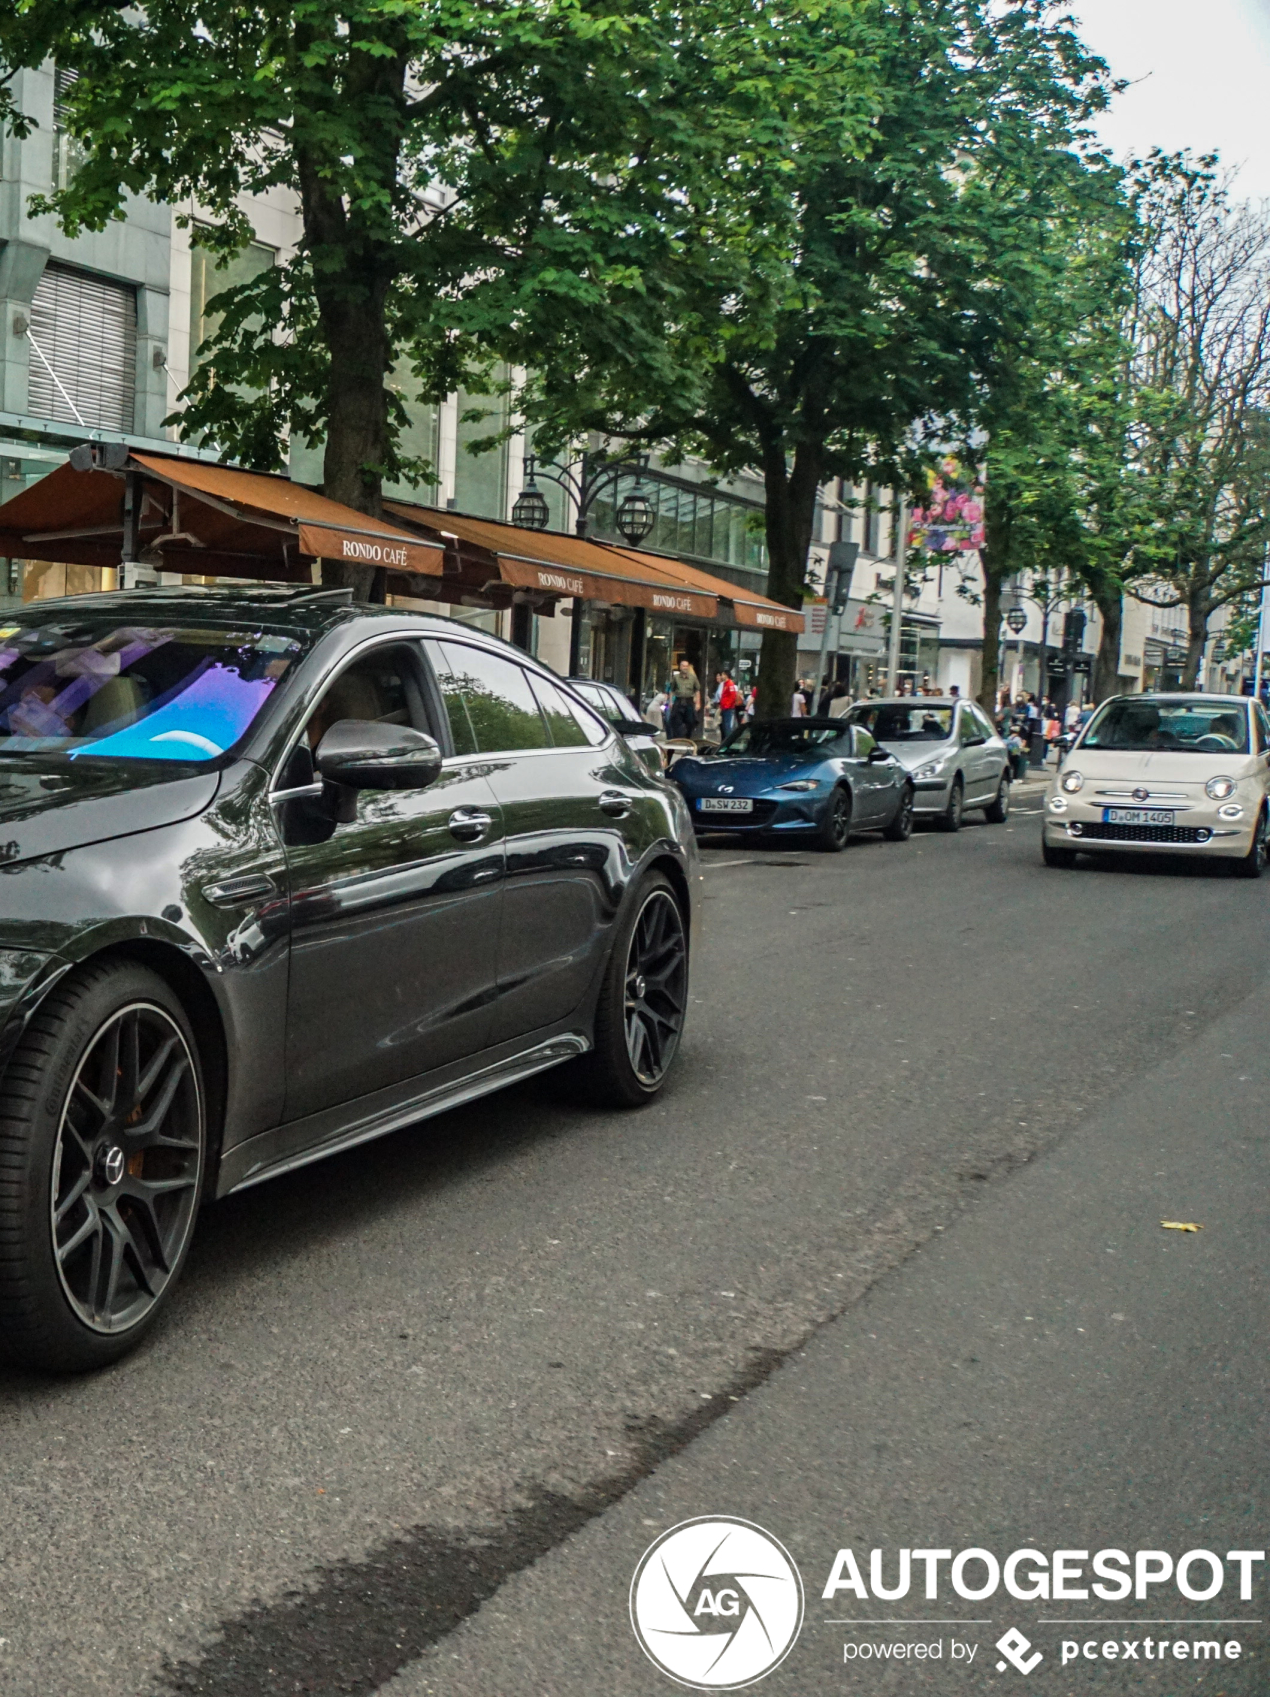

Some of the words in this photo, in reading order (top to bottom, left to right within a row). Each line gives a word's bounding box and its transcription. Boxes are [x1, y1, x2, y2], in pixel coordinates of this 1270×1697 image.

[342, 539, 382, 561] RONDO
[383, 546, 408, 566] CAFÉ
[537, 571, 567, 590] RONDO
[566, 577, 584, 595] CAFÉ
[652, 594, 676, 609] RONDO
[675, 596, 693, 612] CAFÉ
[705, 800, 711, 809] D
[716, 801, 729, 809] SW
[730, 800, 748, 810] 232
[1110, 810, 1118, 821] D
[1142, 812, 1171, 824] 1405
